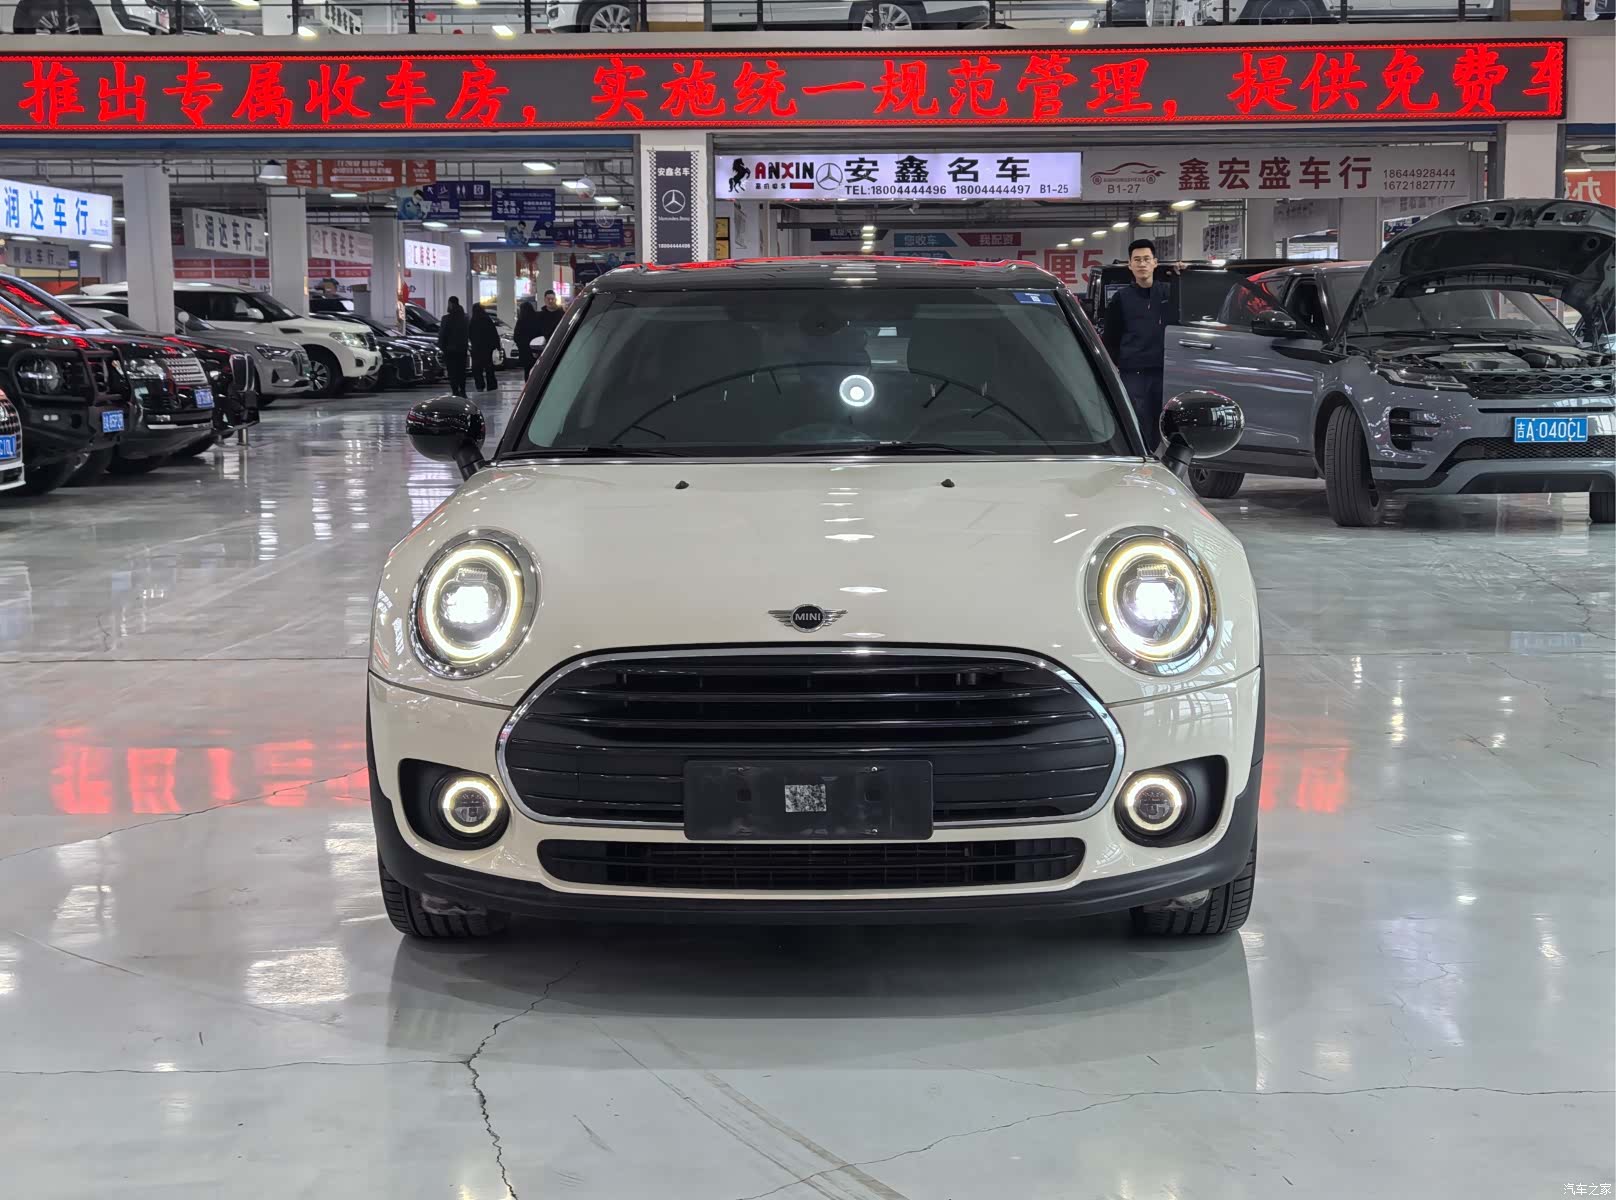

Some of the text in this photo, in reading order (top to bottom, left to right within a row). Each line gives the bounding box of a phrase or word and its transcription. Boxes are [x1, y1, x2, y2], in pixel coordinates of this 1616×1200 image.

[657, 167, 690, 177] 安鑫名车
[754, 161, 815, 180] ANXIN
[844, 155, 1030, 183] 安鑫名车
[1178, 156, 1372, 191] 鑫宏盛车行
[1383, 168, 1456, 179] 18644928444
[845, 183, 1069, 196] TEL:18004444496 18004444497 B1-25
[1107, 183, 1141, 194] B1-27
[1383, 180, 1456, 191] 16721827777
[4, 185, 89, 235] 润达车行
[795, 612, 821, 621] MINI
